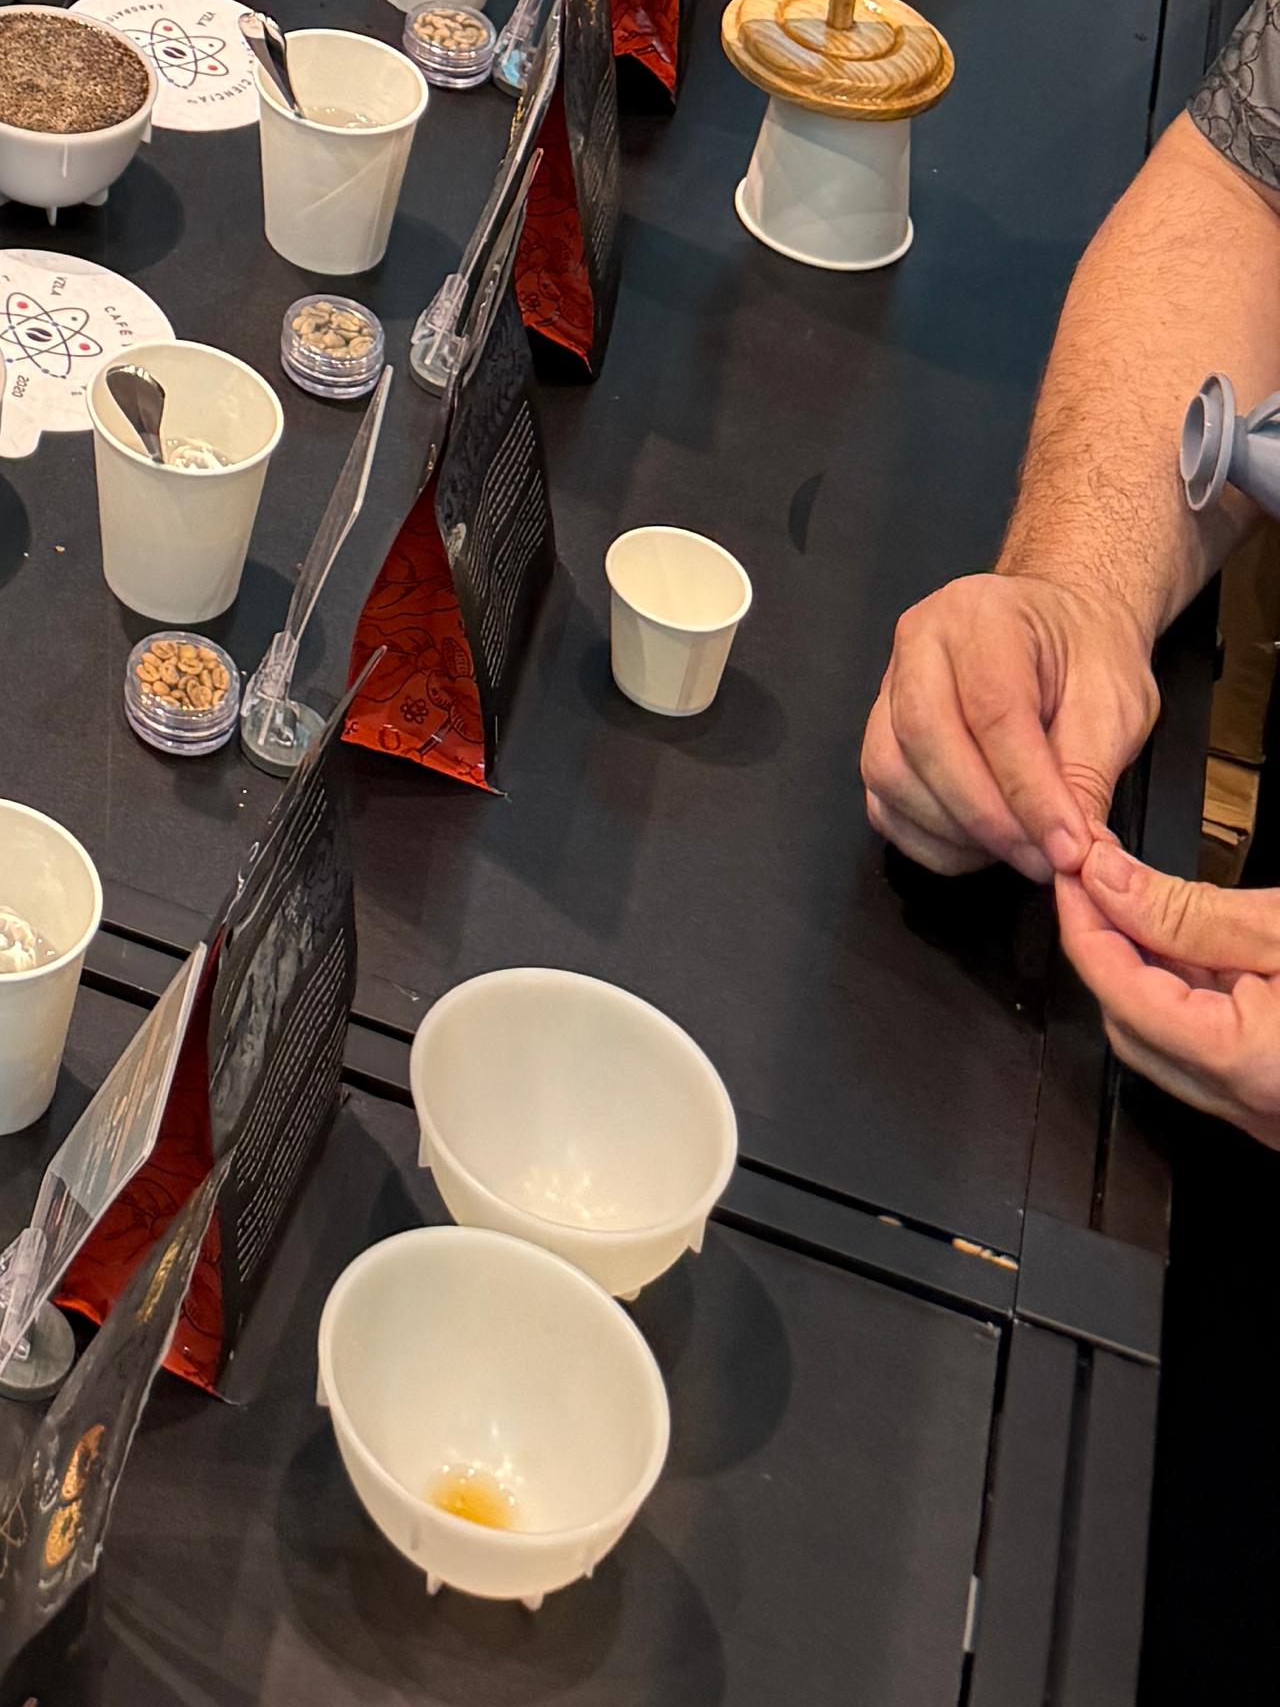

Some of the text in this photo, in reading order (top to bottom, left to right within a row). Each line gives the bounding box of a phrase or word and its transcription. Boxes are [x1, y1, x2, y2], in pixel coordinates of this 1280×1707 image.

[106, 2, 164, 23] LABORATO
[50, 275, 68, 297] VZLA
[104, 305, 134, 337] CAFÉ
